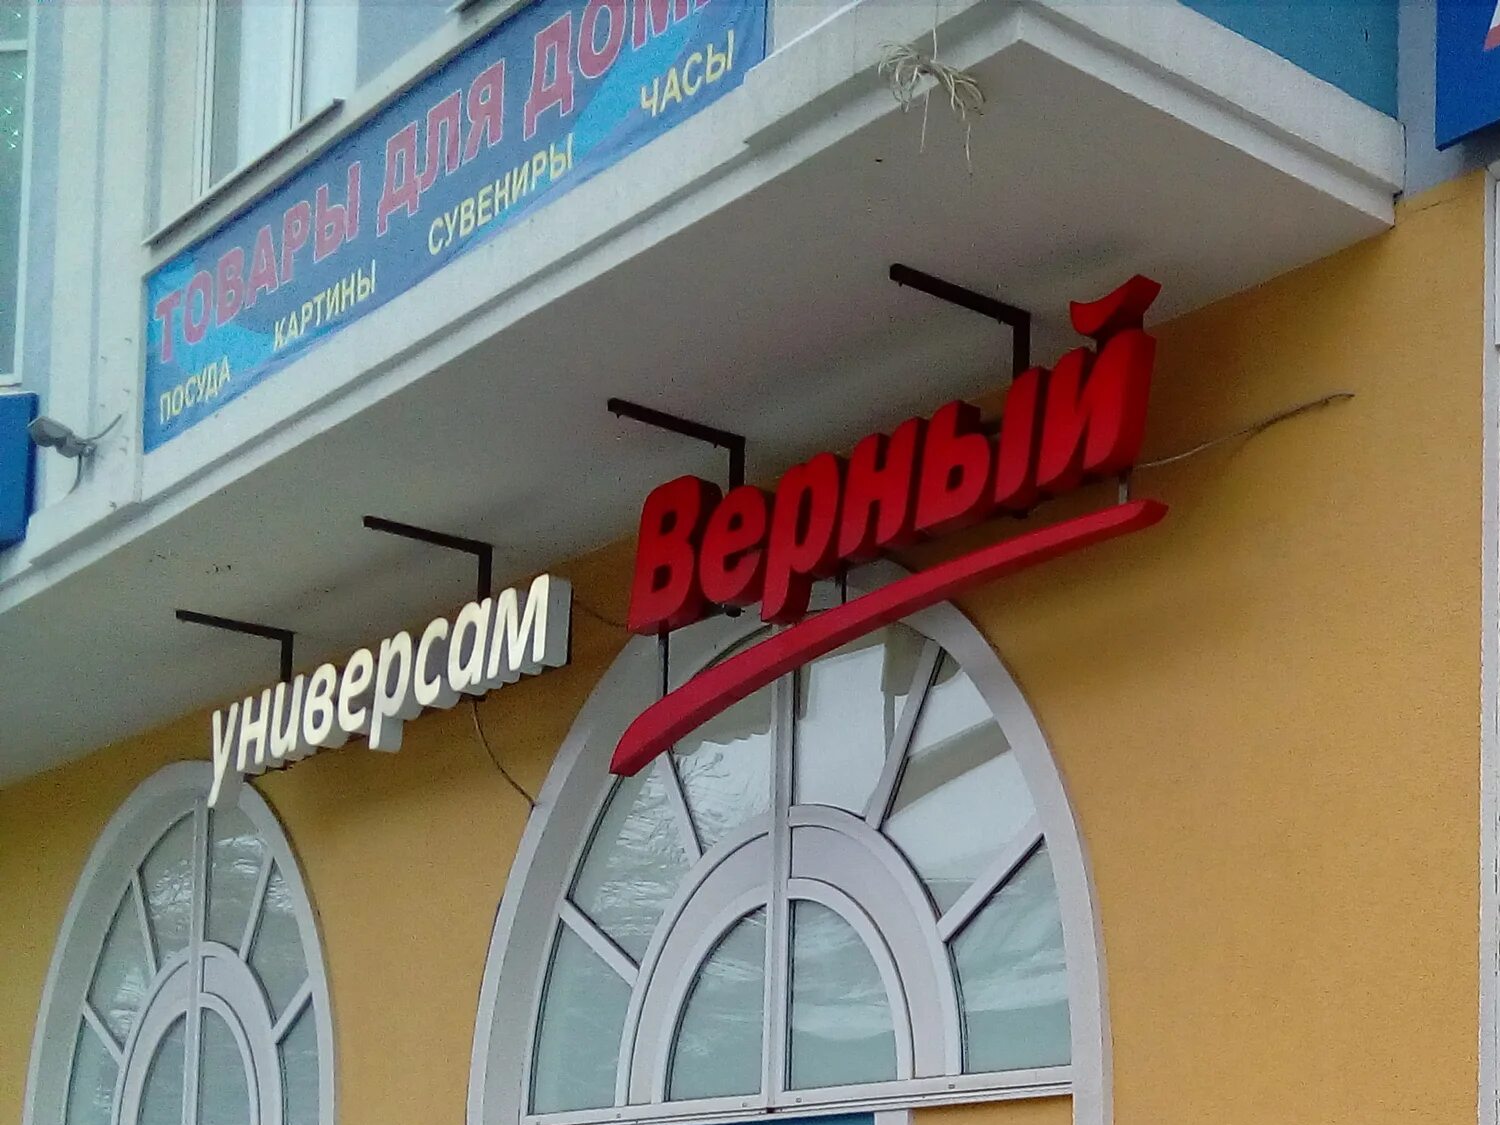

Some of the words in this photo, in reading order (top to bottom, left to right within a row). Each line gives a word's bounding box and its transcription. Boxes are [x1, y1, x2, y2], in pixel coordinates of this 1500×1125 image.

[153, 162, 361, 363] ТОВАРЫ
[377, 58, 505, 237] ДЛЯ
[159, 355, 231, 425] ПОСУДА
[273, 259, 376, 352] КАРТИНЫ
[427, 133, 573, 256] СУВЕНИРЫ
[640, 30, 734, 117] ЧАСЫ
[627, 274, 1160, 634] Верный
[206, 574, 572, 807] универсам
